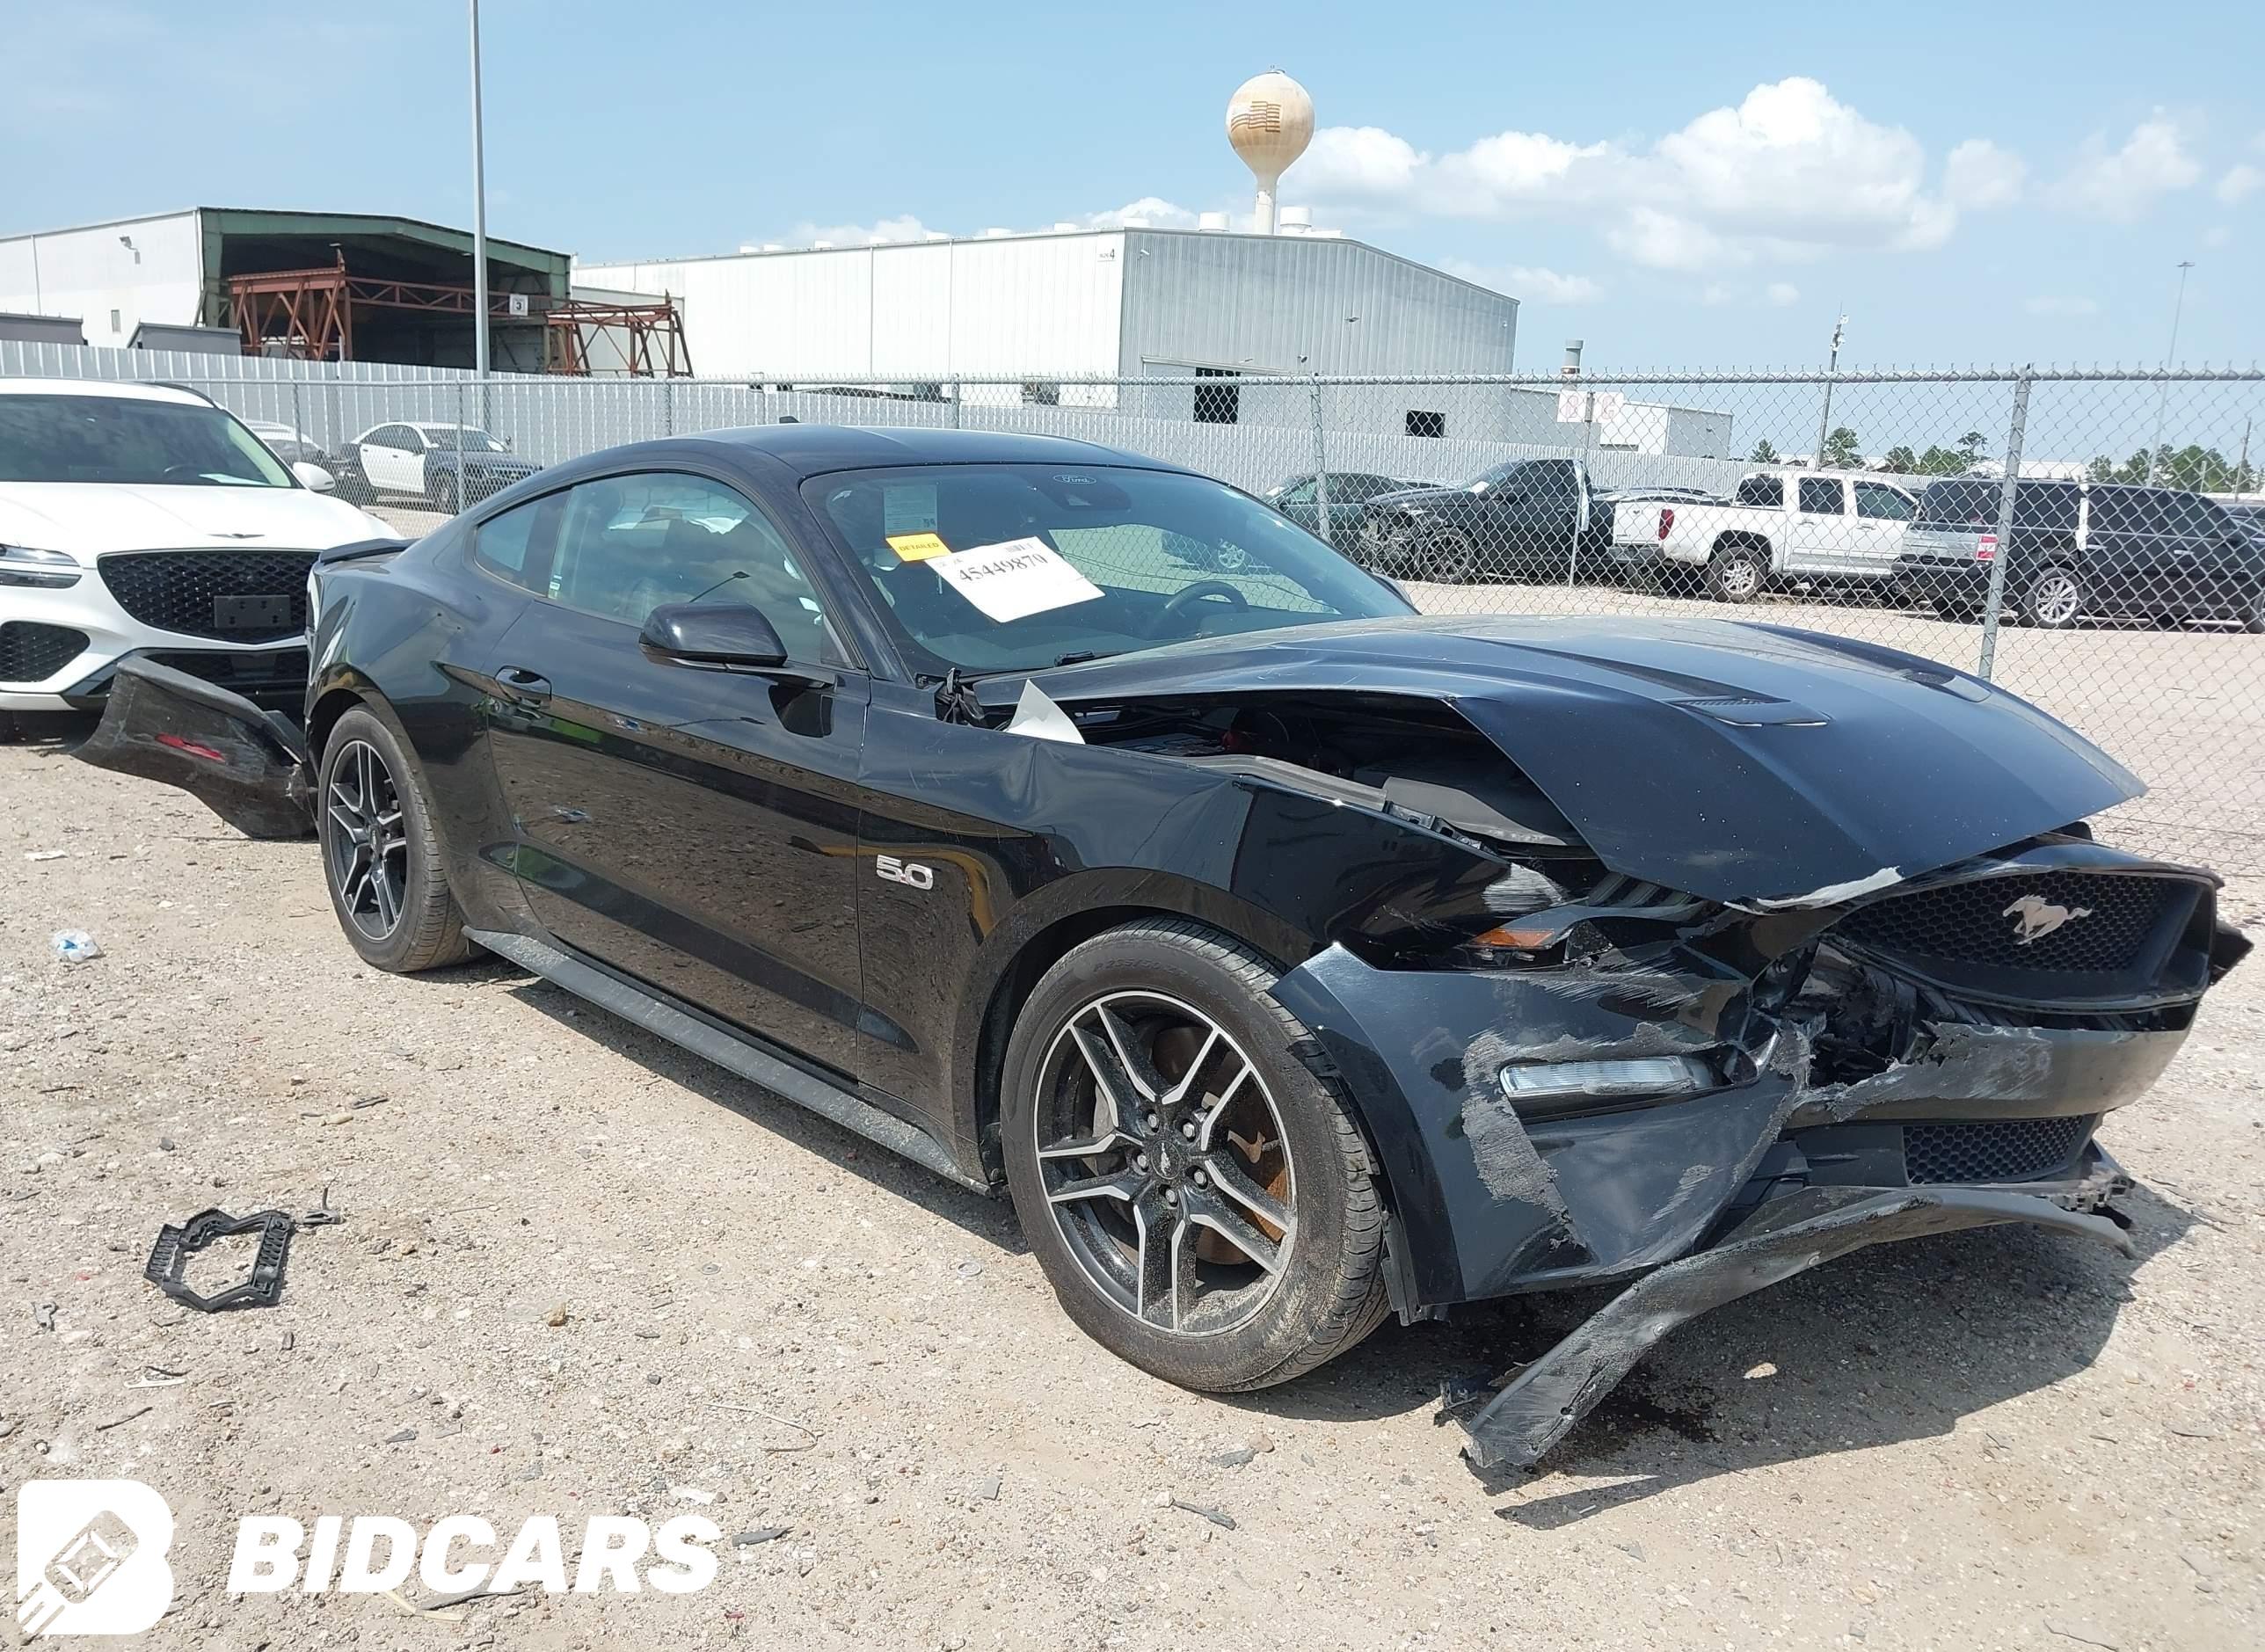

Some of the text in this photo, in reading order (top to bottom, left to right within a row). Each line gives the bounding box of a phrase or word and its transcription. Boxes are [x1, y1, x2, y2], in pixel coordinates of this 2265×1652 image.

[516, 302, 522, 310] 3
[899, 542, 940, 552] DETAILED
[876, 854, 933, 891] 5.0
